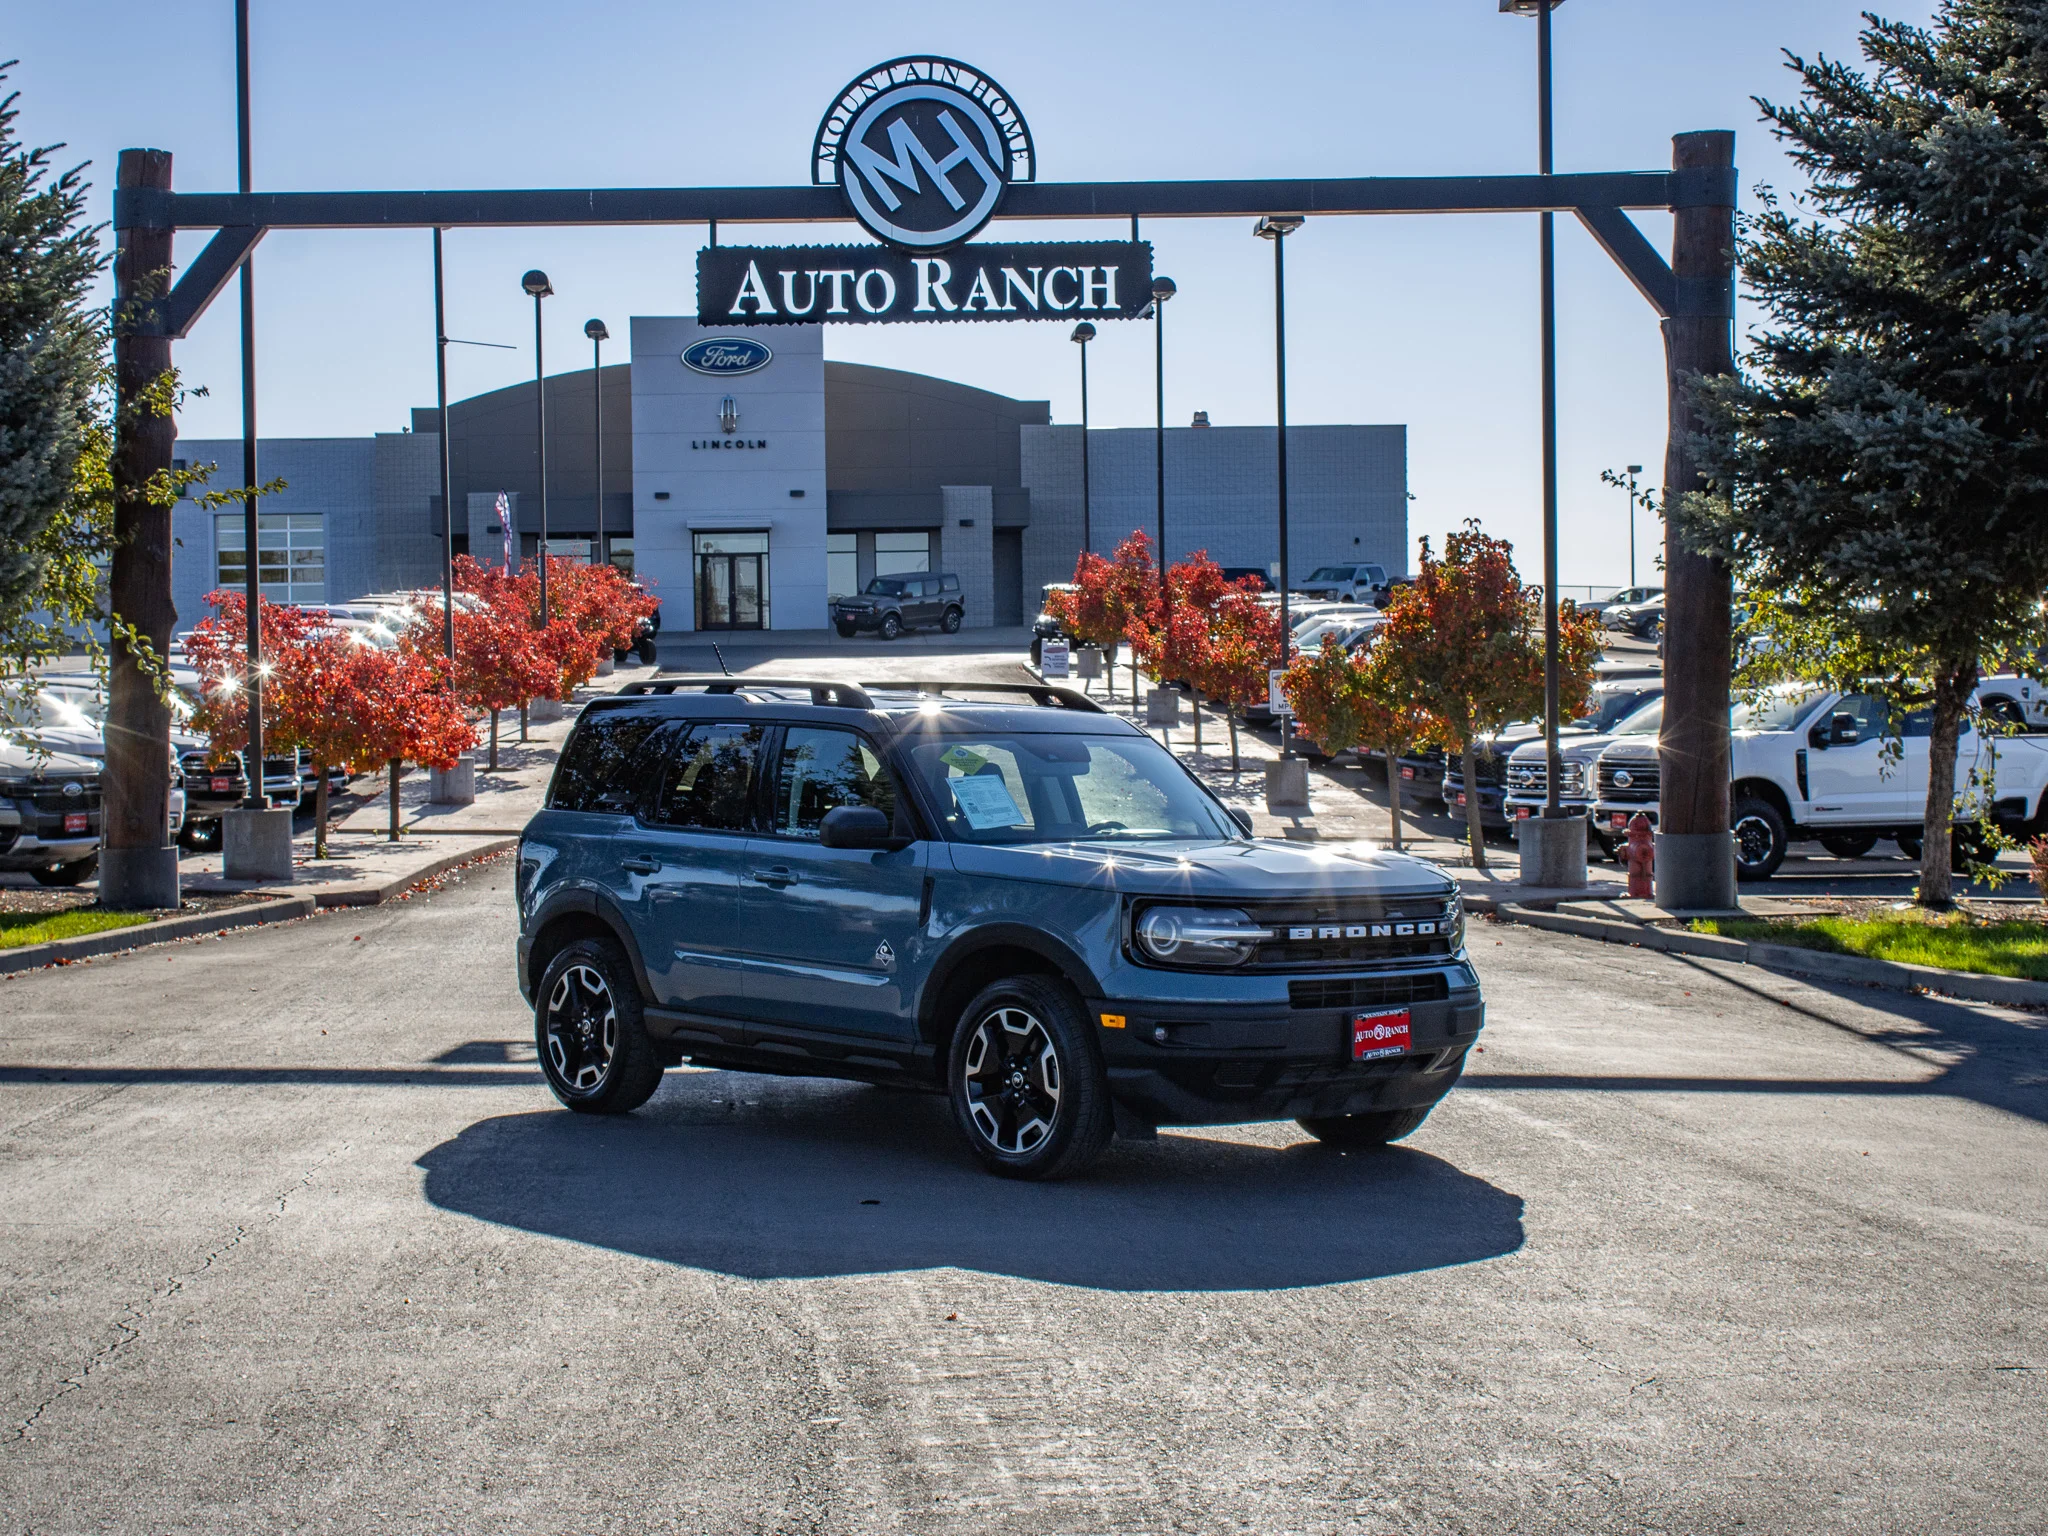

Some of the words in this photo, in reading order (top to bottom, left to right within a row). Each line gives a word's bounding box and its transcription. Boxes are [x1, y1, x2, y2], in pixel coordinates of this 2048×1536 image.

[818, 62, 961, 163] MOUNTAIN
[970, 77, 1029, 163] HOME
[844, 109, 1002, 213] MH
[728, 259, 896, 315] AUTO
[911, 257, 1122, 313] RANCH
[701, 345, 753, 368] Ford
[692, 439, 767, 450] LINCOLN
[1289, 922, 1436, 939] BRONCO
[1355, 1030, 1374, 1042] AUTO
[1385, 1025, 1408, 1038] RANCH
